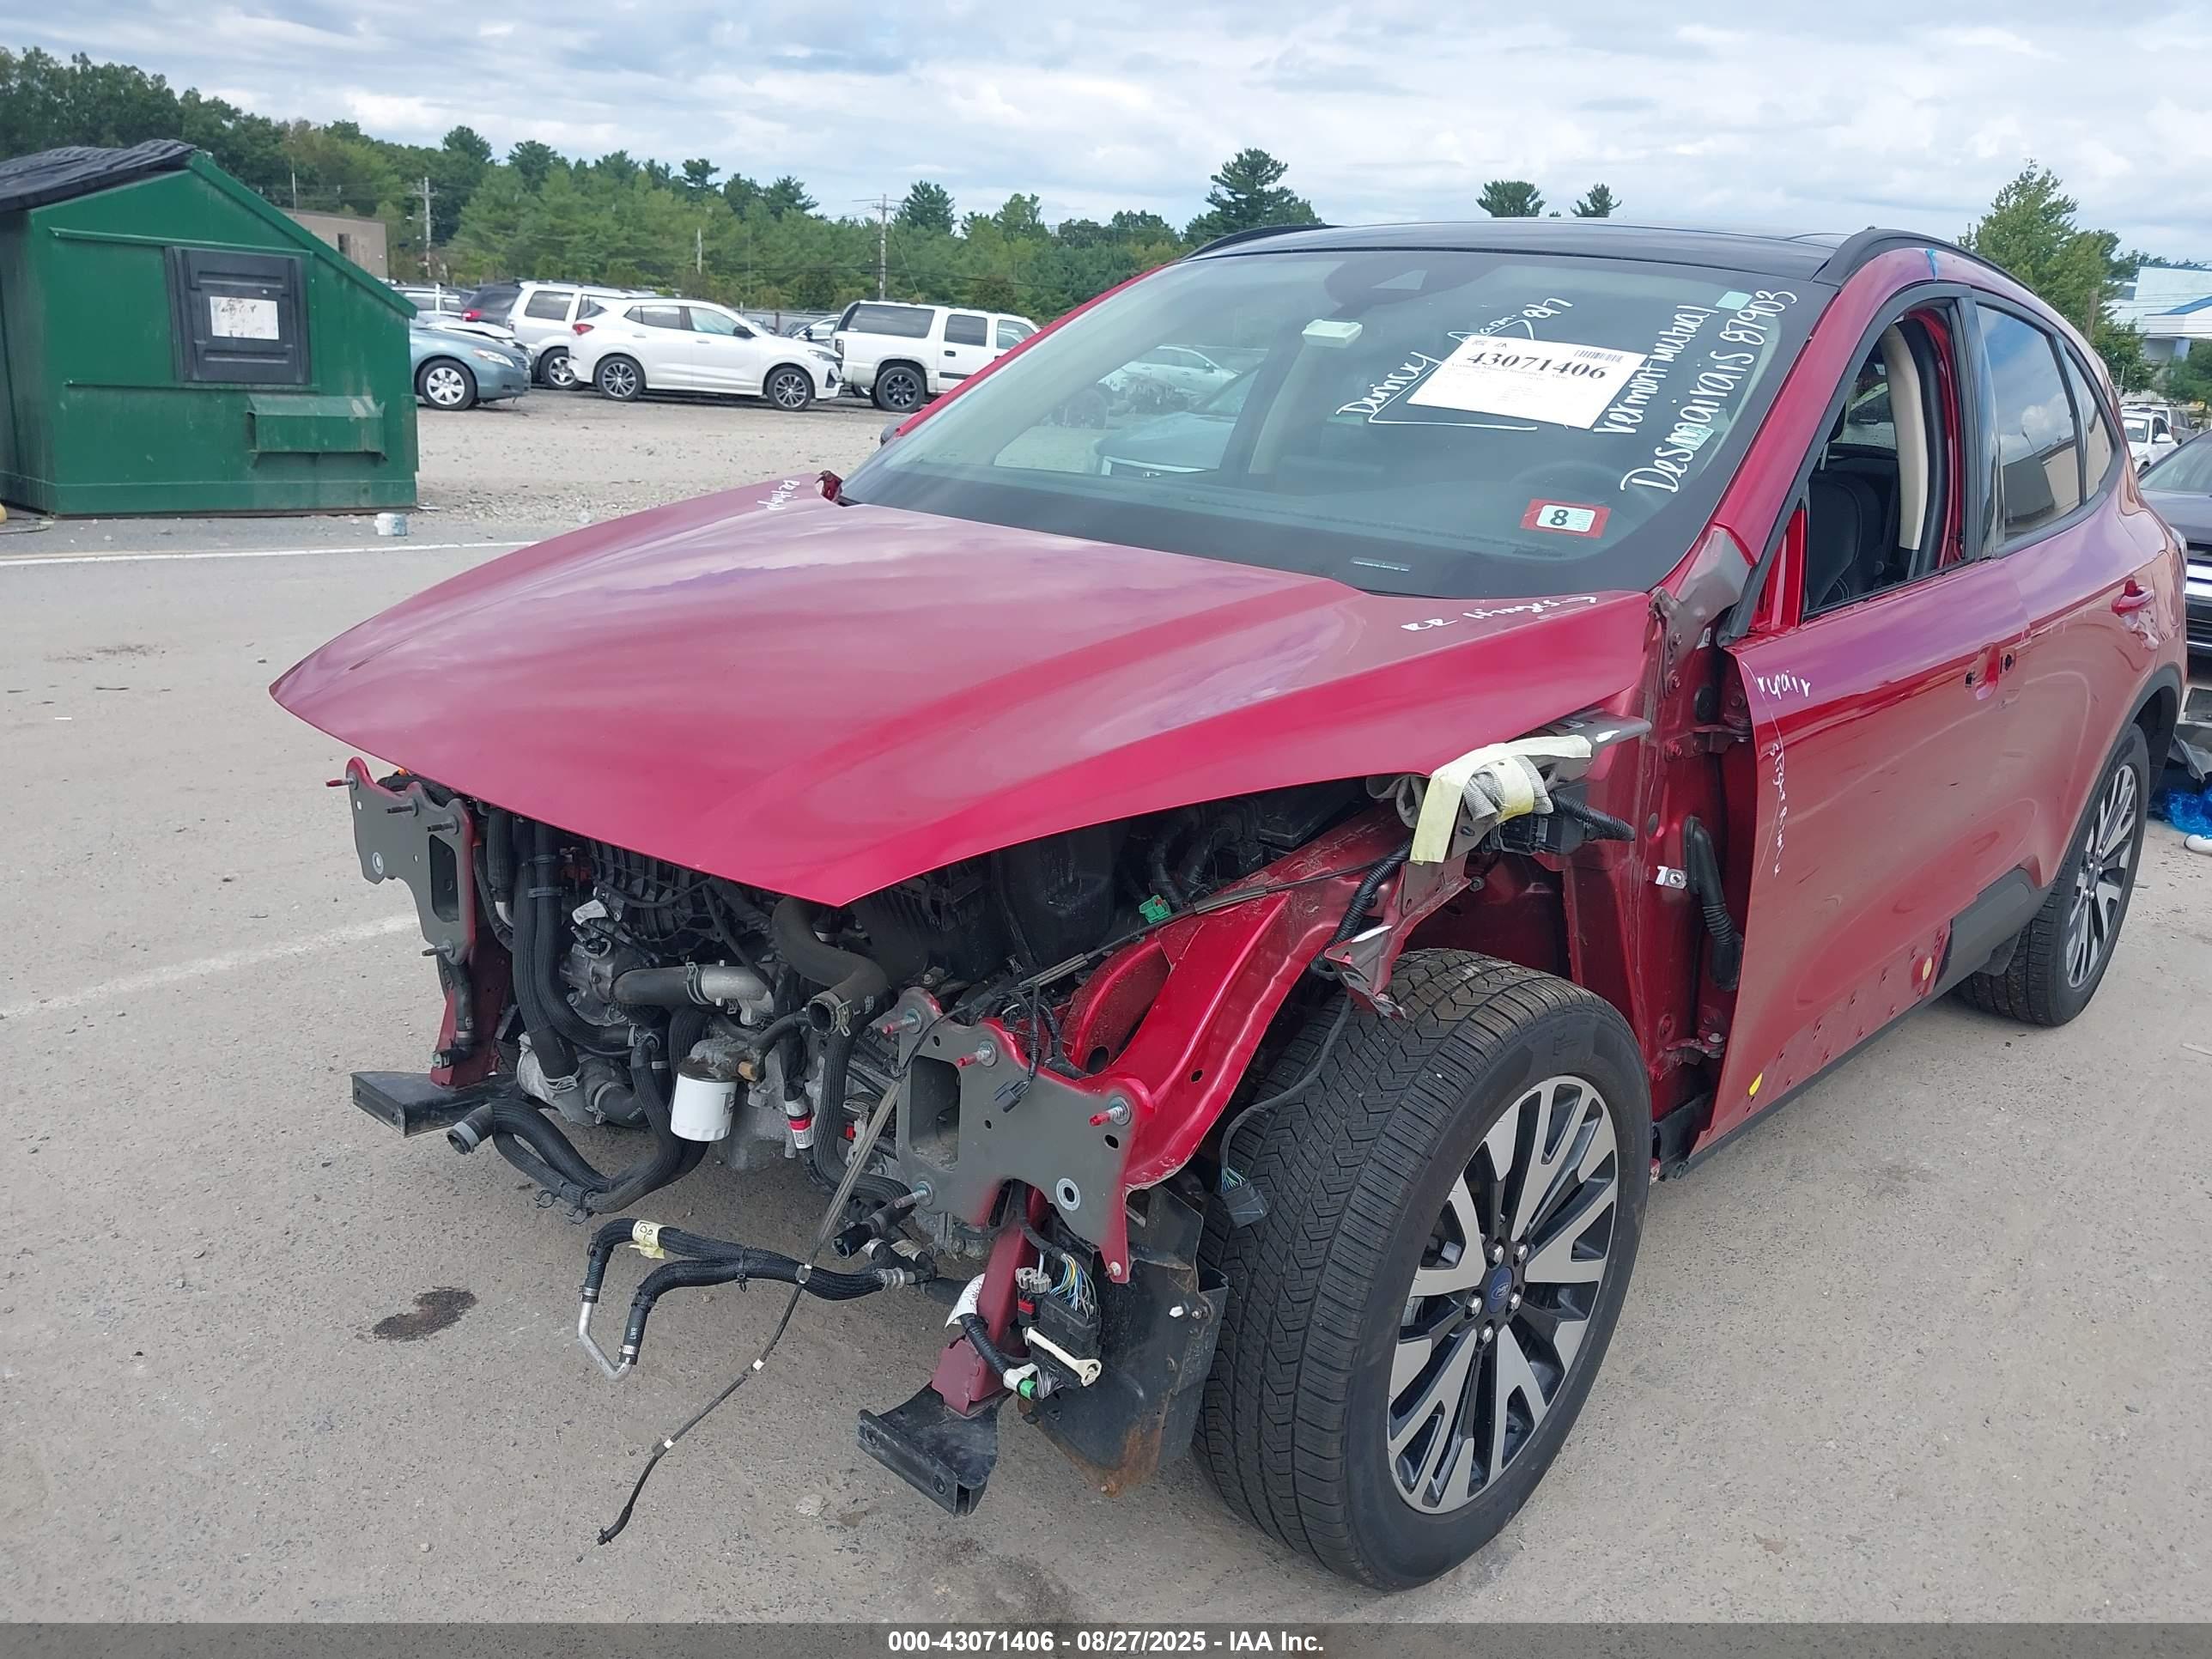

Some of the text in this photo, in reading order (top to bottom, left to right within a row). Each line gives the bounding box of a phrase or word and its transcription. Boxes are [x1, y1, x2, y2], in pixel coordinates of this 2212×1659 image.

[1718, 289, 1799, 346] 87903
[1466, 350, 1607, 380] 43071406
[1550, 509, 1569, 526] 8
